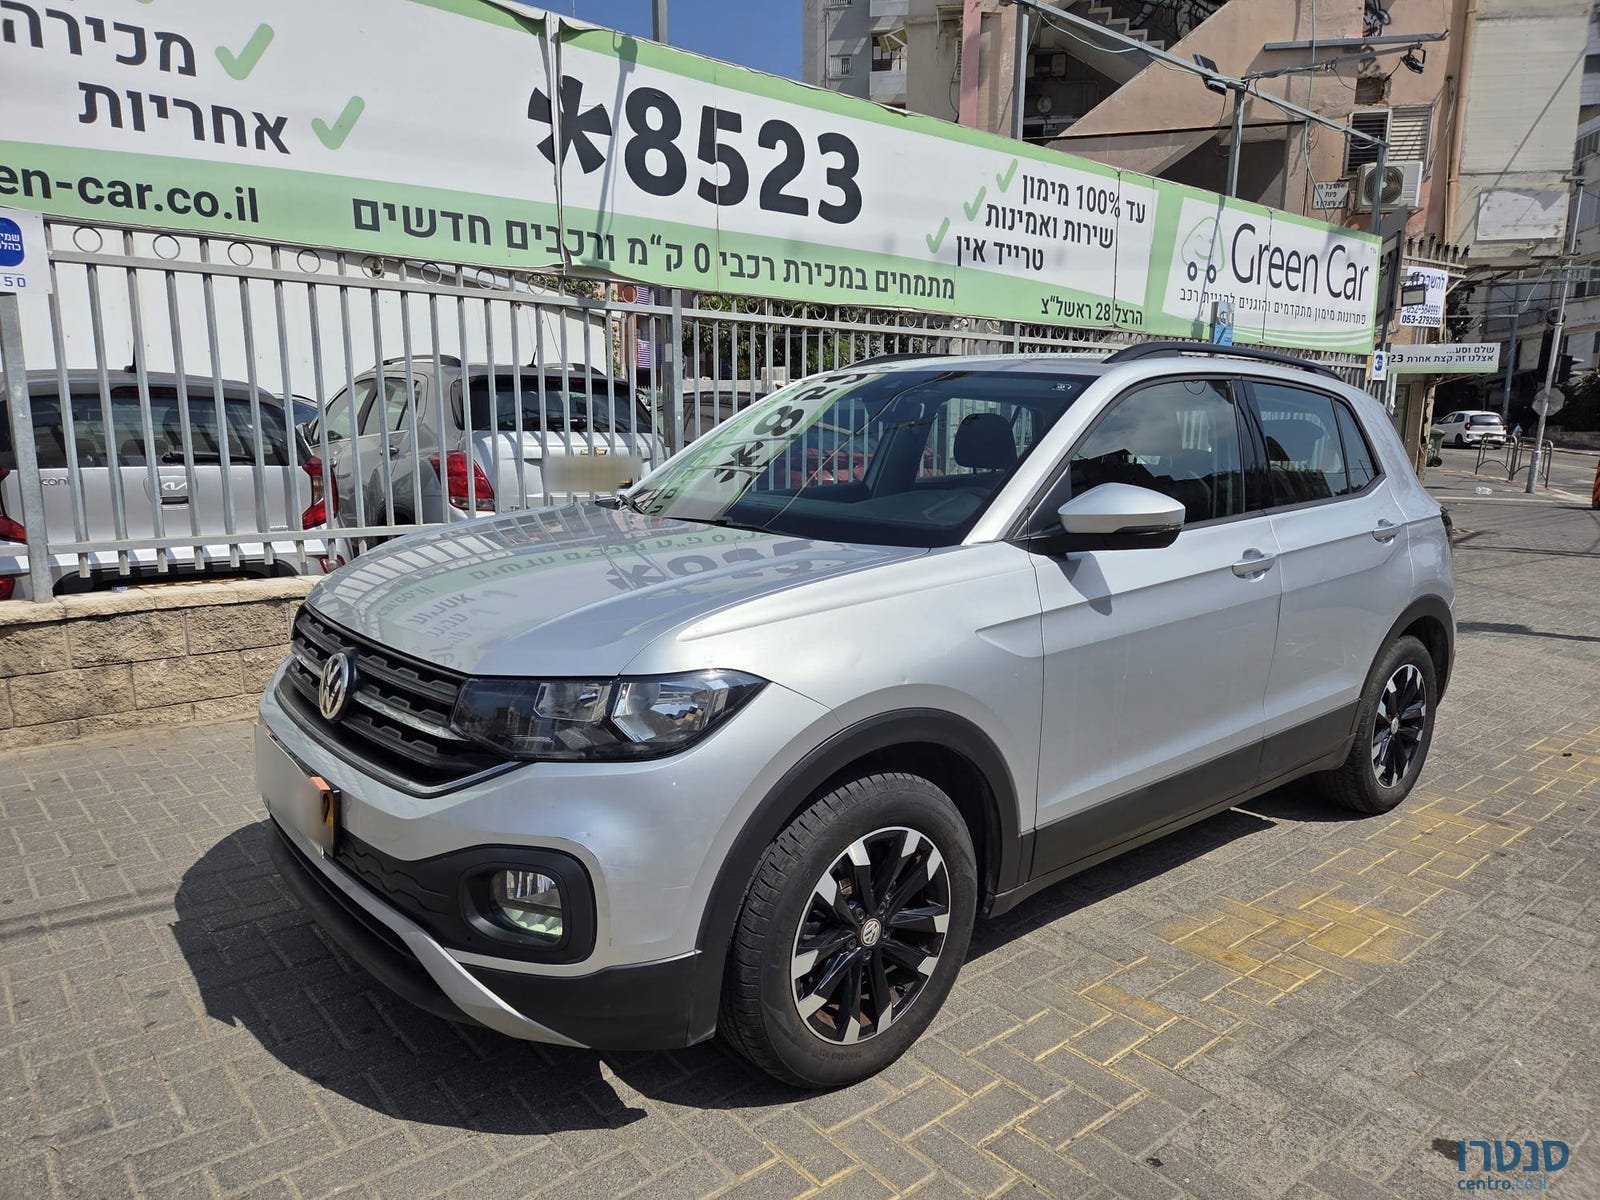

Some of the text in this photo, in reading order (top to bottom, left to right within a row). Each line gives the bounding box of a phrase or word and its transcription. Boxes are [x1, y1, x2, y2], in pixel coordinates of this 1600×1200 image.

[0, 0, 196, 77] מכירה
[78, 81, 291, 155] אחריות
[1023, 174, 1146, 224] עד 100% מימון
[985, 203, 1114, 249] שירות ואמינות
[352, 197, 955, 300] מתמחים במכירת רכבי 0 ק"מ ורכבים חדשים
[956, 235, 1044, 271] טרייד אין
[1231, 223, 1369, 302] Green Car
[1041, 295, 1143, 326] הרצל 28 ראשל"צ
[1180, 288, 1199, 303] רכב
[1239, 296, 1271, 312] והוגנים
[1274, 302, 1312, 319] מתקדמים
[1315, 307, 1335, 322] מימון
[1337, 311, 1367, 325] פתרונות
[1406, 354, 1494, 364] אצלנו זה קצת אחרת
[1474, 345, 1495, 354] שלם
